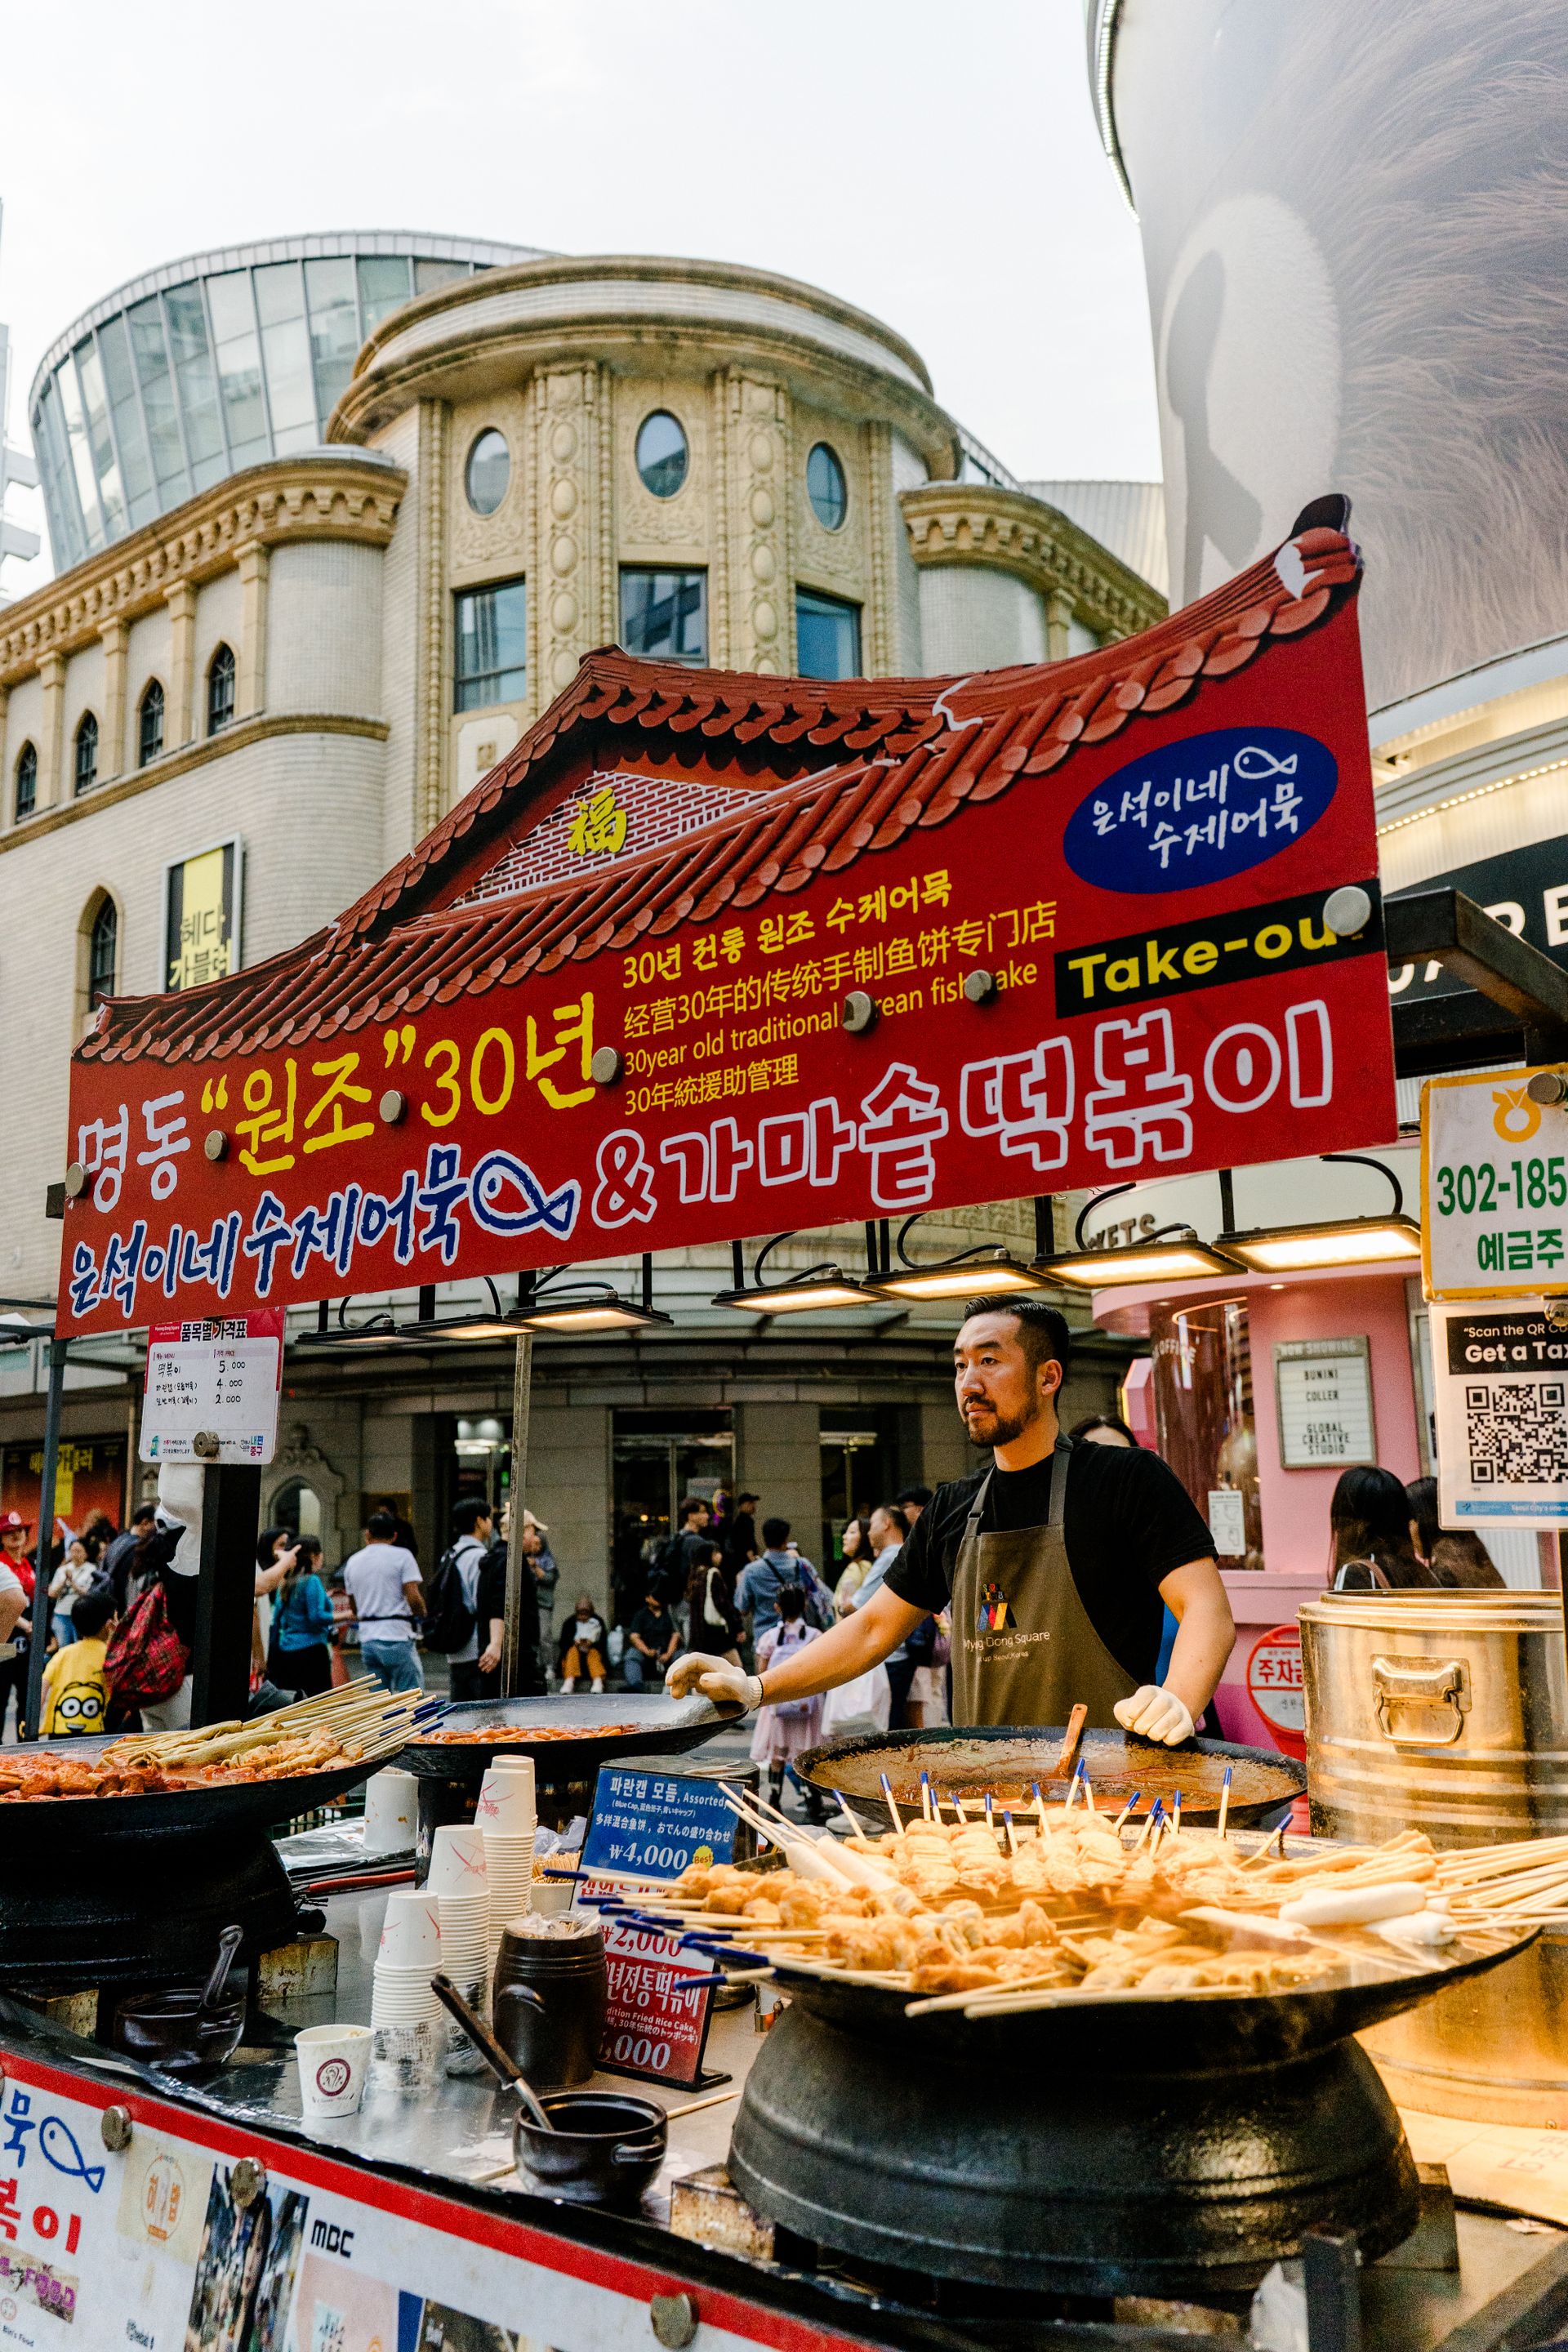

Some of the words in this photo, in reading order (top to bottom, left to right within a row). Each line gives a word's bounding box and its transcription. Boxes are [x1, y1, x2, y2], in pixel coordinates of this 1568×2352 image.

[1093, 764, 1230, 836] 은석이네
[567, 787, 627, 856] 福
[1148, 783, 1303, 869] 수제어묵
[622, 943, 681, 987] 30년
[757, 911, 815, 954] 원조
[1068, 918, 1338, 999] Take-ou
[624, 900, 1057, 1039] 经营30年的传统手制鱼饼专门店
[625, 1043, 687, 1078] 30year
[693, 1029, 724, 1060] old
[731, 1001, 839, 1051] traditional
[996, 960, 1037, 991] ake
[625, 1054, 799, 1116] 30年統援助管理
[78, 1090, 190, 1213] 명동
[1437, 1156, 1567, 1216] 302-185
[69, 1210, 243, 1317] 은석이네
[244, 1144, 469, 1298] 수제어묵
[1477, 1229, 1565, 1271] 예금주
[181, 1321, 212, 1342] 품목별
[213, 1319, 247, 1340] 가격표
[1503, 1325, 1524, 1337] the
[1527, 1323, 1545, 1334] QR
[1465, 1344, 1507, 1364] Get
[1512, 1348, 1527, 1361] a
[1303, 1432, 1350, 1445] CREATIVE
[1307, 1422, 1343, 1433] GLOBAL
[1308, 1445, 1346, 1454] STUDIO
[986, 1637, 1013, 1648] Dong
[1015, 1631, 1050, 1645] Square
[610, 1776, 648, 1799] 파란캡
[609, 1842, 688, 1870] ₩4,000
[694, 1853, 712, 1865] Best
[632, 2012, 654, 2024] Fried
[656, 2018, 673, 2029] Rice
[674, 2021, 697, 2035] Cake,
[599, 2032, 671, 2070] ,000
[2, 2089, 35, 2168] 묵
[311, 2219, 354, 2258] MBC
